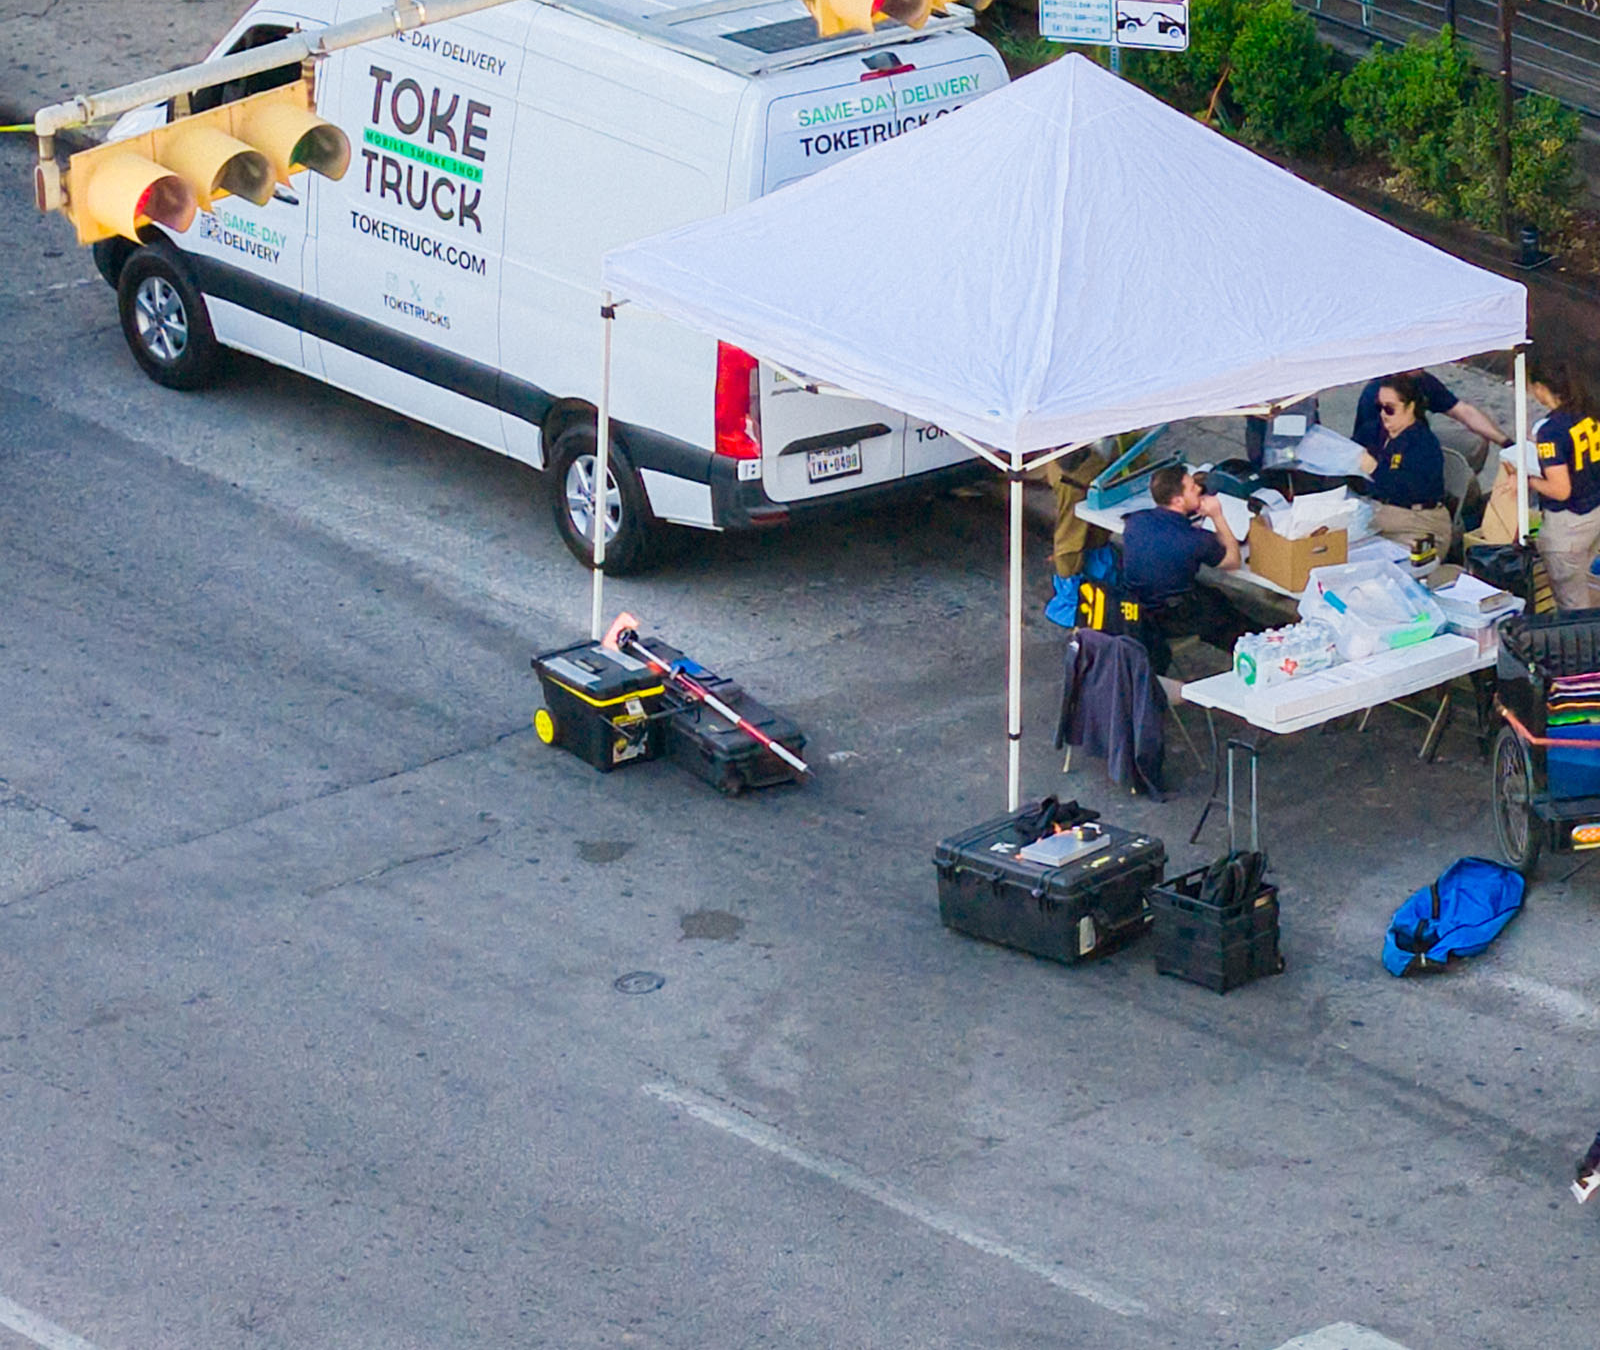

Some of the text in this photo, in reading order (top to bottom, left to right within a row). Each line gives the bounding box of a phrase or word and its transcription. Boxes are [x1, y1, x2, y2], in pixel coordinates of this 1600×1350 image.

[442, 41, 506, 76] DELIVERY
[369, 64, 492, 162] TOKE
[798, 73, 980, 128] SAME-DAY DELIVERY
[361, 147, 482, 234] TRUCK
[223, 211, 287, 248] SAME-DAY
[224, 230, 280, 263] DELIVERY
[350, 210, 486, 276] TOKETRUCK.COM
